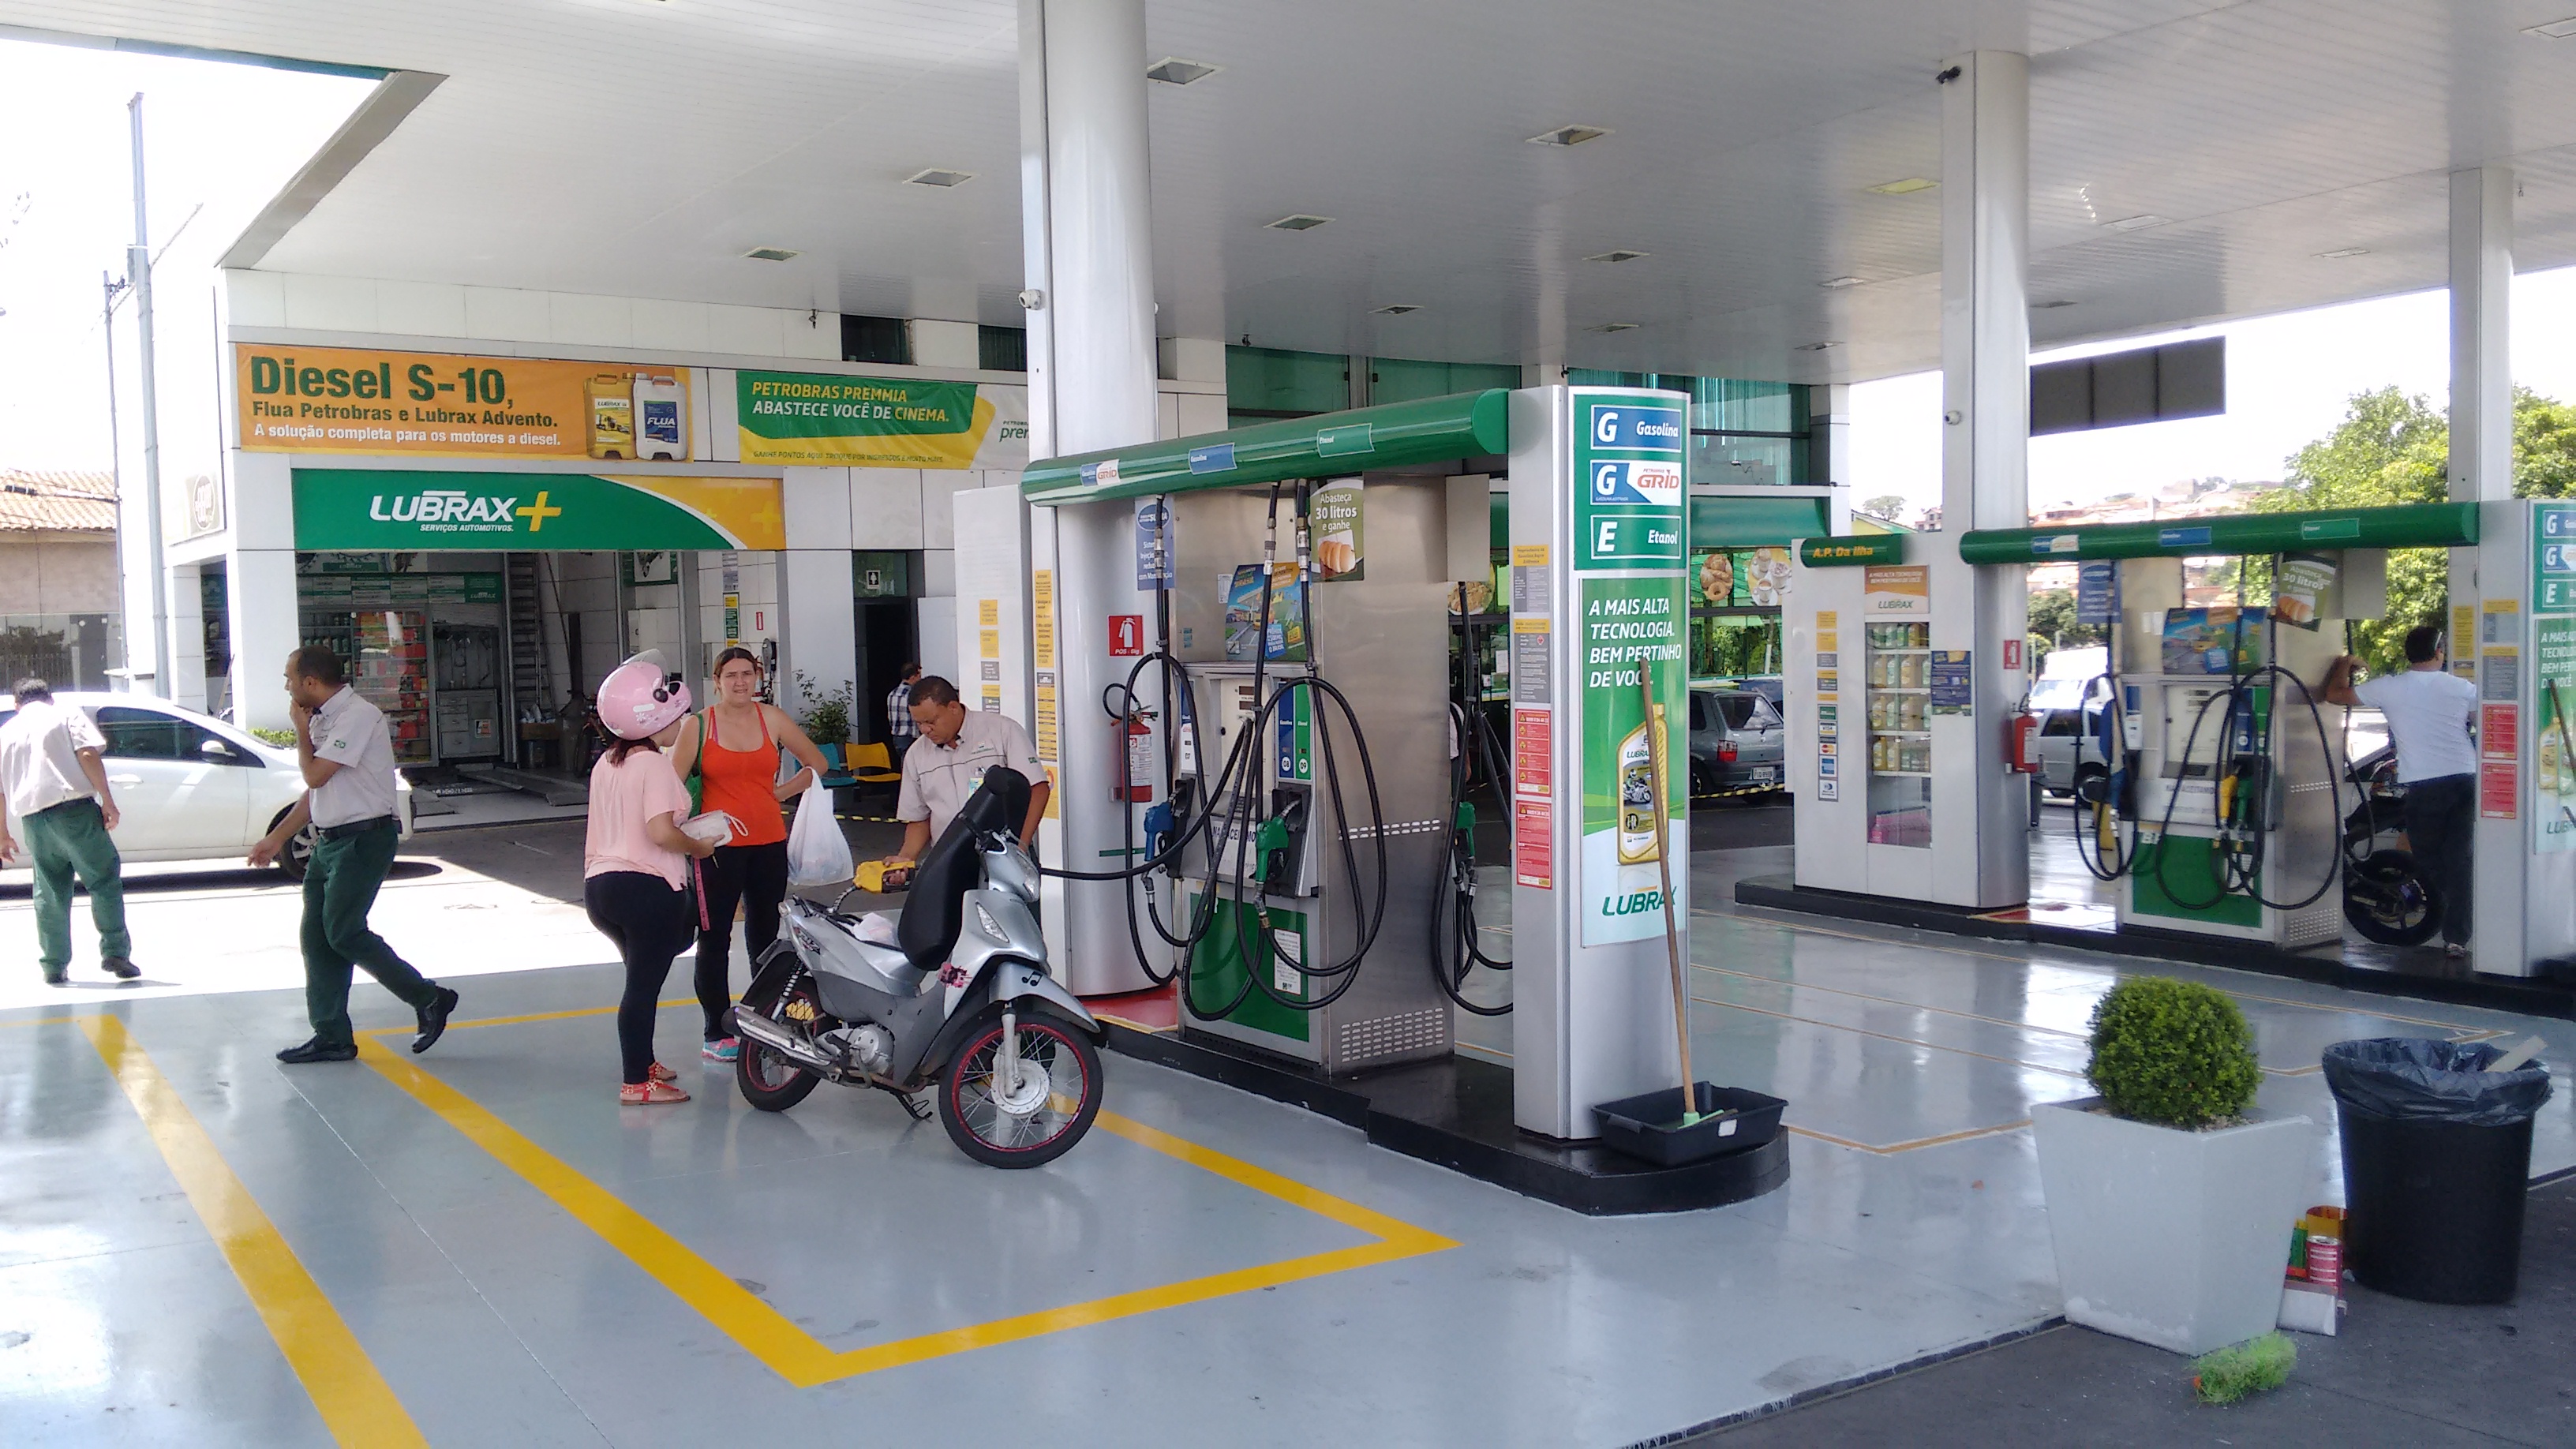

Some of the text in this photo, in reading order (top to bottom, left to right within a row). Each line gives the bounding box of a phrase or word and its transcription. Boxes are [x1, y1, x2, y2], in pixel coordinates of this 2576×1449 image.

[250, 356, 514, 409] Diesel S-10,
[752, 382, 907, 402] PETROBRAS PREMMIA
[252, 401, 559, 428] Flua Petrobras e Lubrax Advento.
[752, 400, 949, 422] ABASTECE VOCÊ DE CINEMA.
[254, 423, 562, 446] A solução completa para os motores a diesel.
[1597, 412, 1679, 443] G Gasolina
[1596, 465, 1617, 496] G
[1320, 492, 1352, 504] Abasteça
[1316, 506, 1357, 520] 30 litros
[420, 524, 458, 534] SERVIÇOS
[1328, 521, 1350, 533] ganhe
[2546, 515, 2557, 534] G
[1597, 522, 1678, 552] E Etanol
[2545, 547, 2557, 566] G
[2282, 573, 2296, 582] 30
[2546, 583, 2557, 603] E
[1589, 598, 1669, 616] A MAIS ALTA
[1878, 600, 1914, 608] LUBRAX
[2540, 633, 2548, 642] A
[2549, 632, 2567, 642] MAIS
[1589, 644, 1682, 664] BEM PERTINHO
[2541, 662, 2559, 673] BEM
[1589, 671, 1612, 687] DE
[1627, 749, 1649, 758] LUBRA
